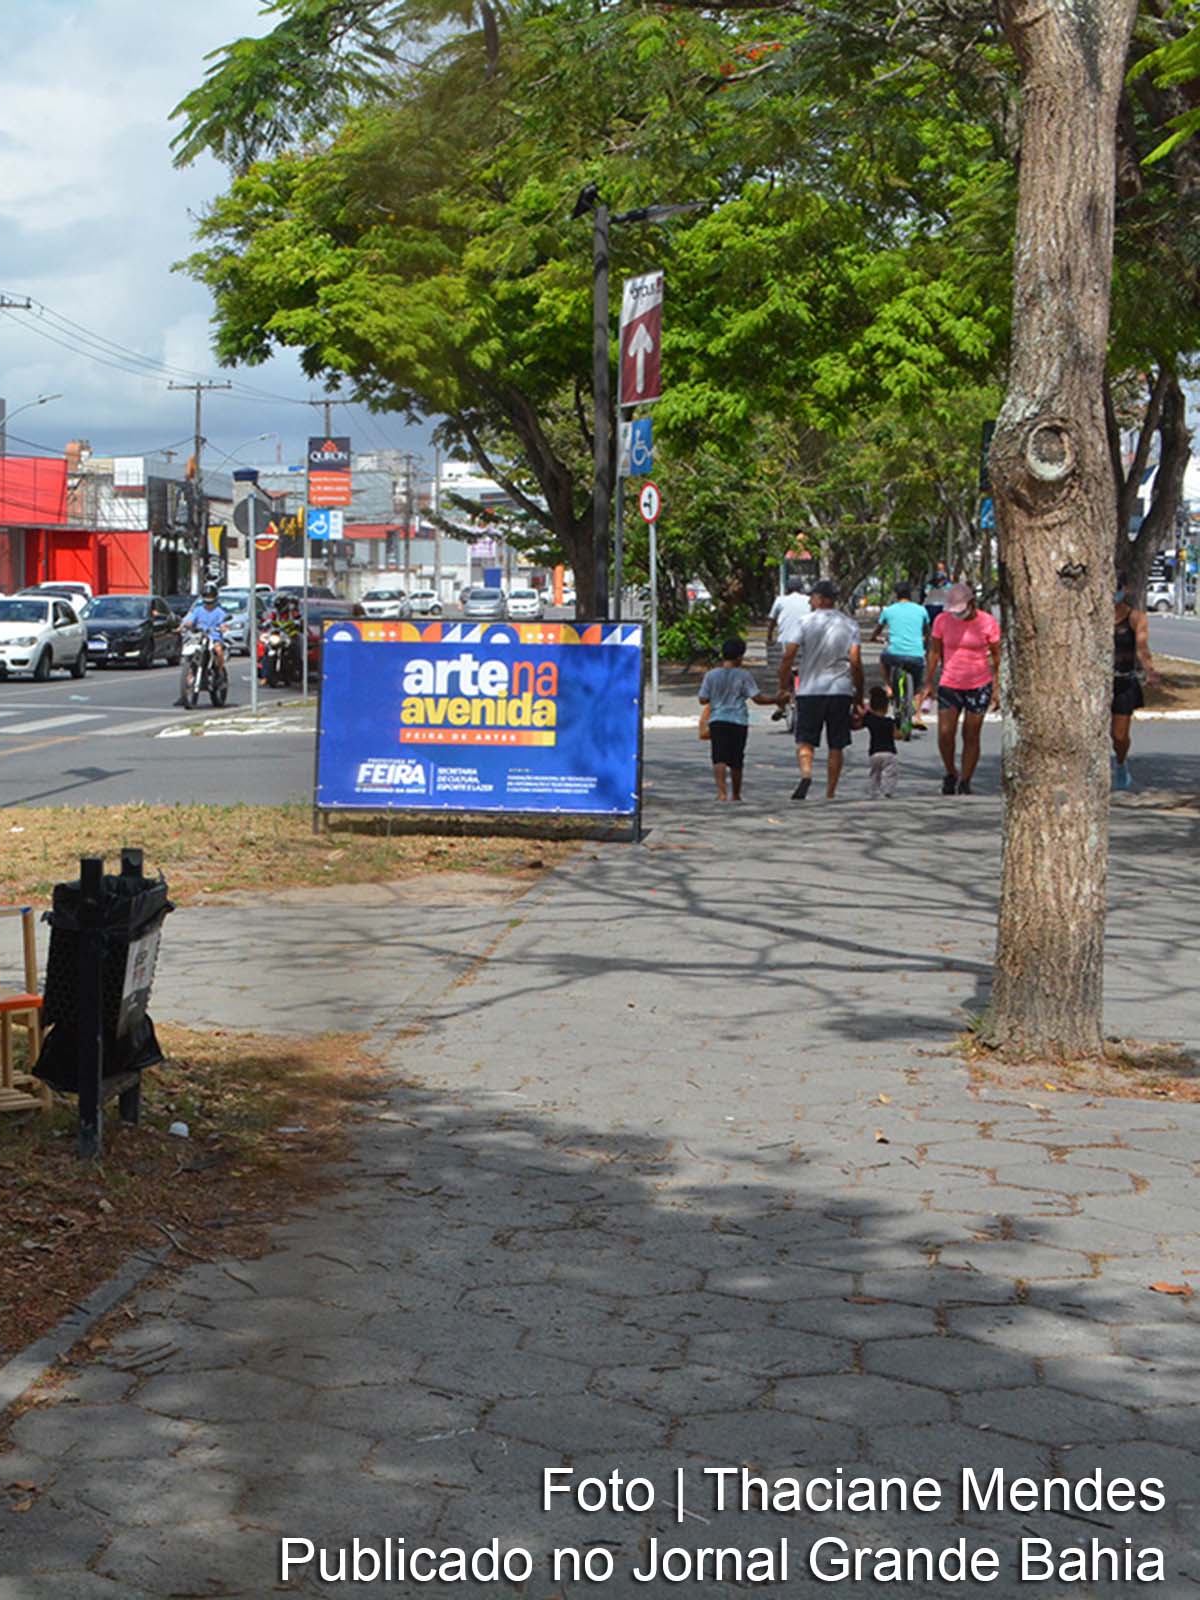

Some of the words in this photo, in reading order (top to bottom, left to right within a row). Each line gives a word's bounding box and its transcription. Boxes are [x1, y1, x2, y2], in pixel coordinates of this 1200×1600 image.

[402, 653, 509, 696] arte
[512, 661, 559, 697] na
[400, 690, 558, 727] avenida
[405, 732, 445, 741] FEIRA
[475, 734, 517, 742] ARTES
[356, 763, 426, 785] FEIRA
